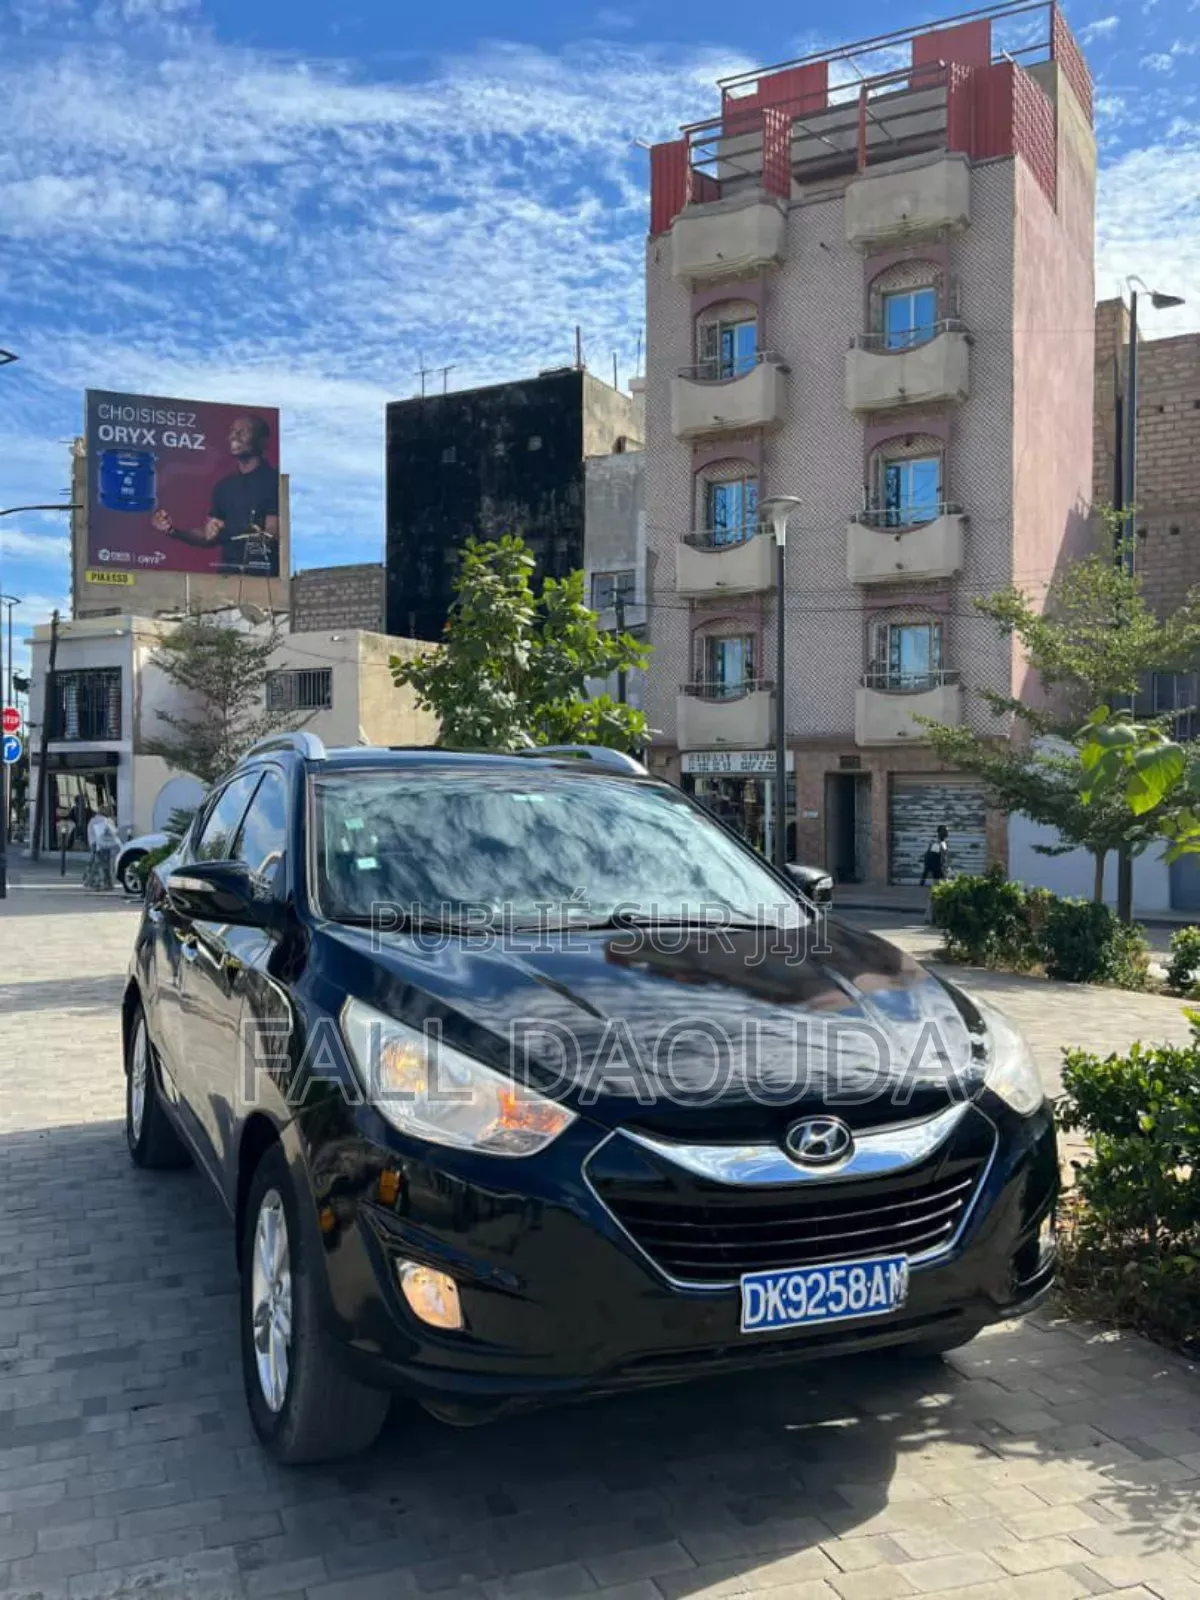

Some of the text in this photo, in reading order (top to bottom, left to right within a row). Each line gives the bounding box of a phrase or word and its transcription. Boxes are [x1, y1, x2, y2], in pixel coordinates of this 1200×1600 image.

[98, 404, 196, 428] CHOISISSEZ
[98, 425, 206, 450] ORYX GAZ
